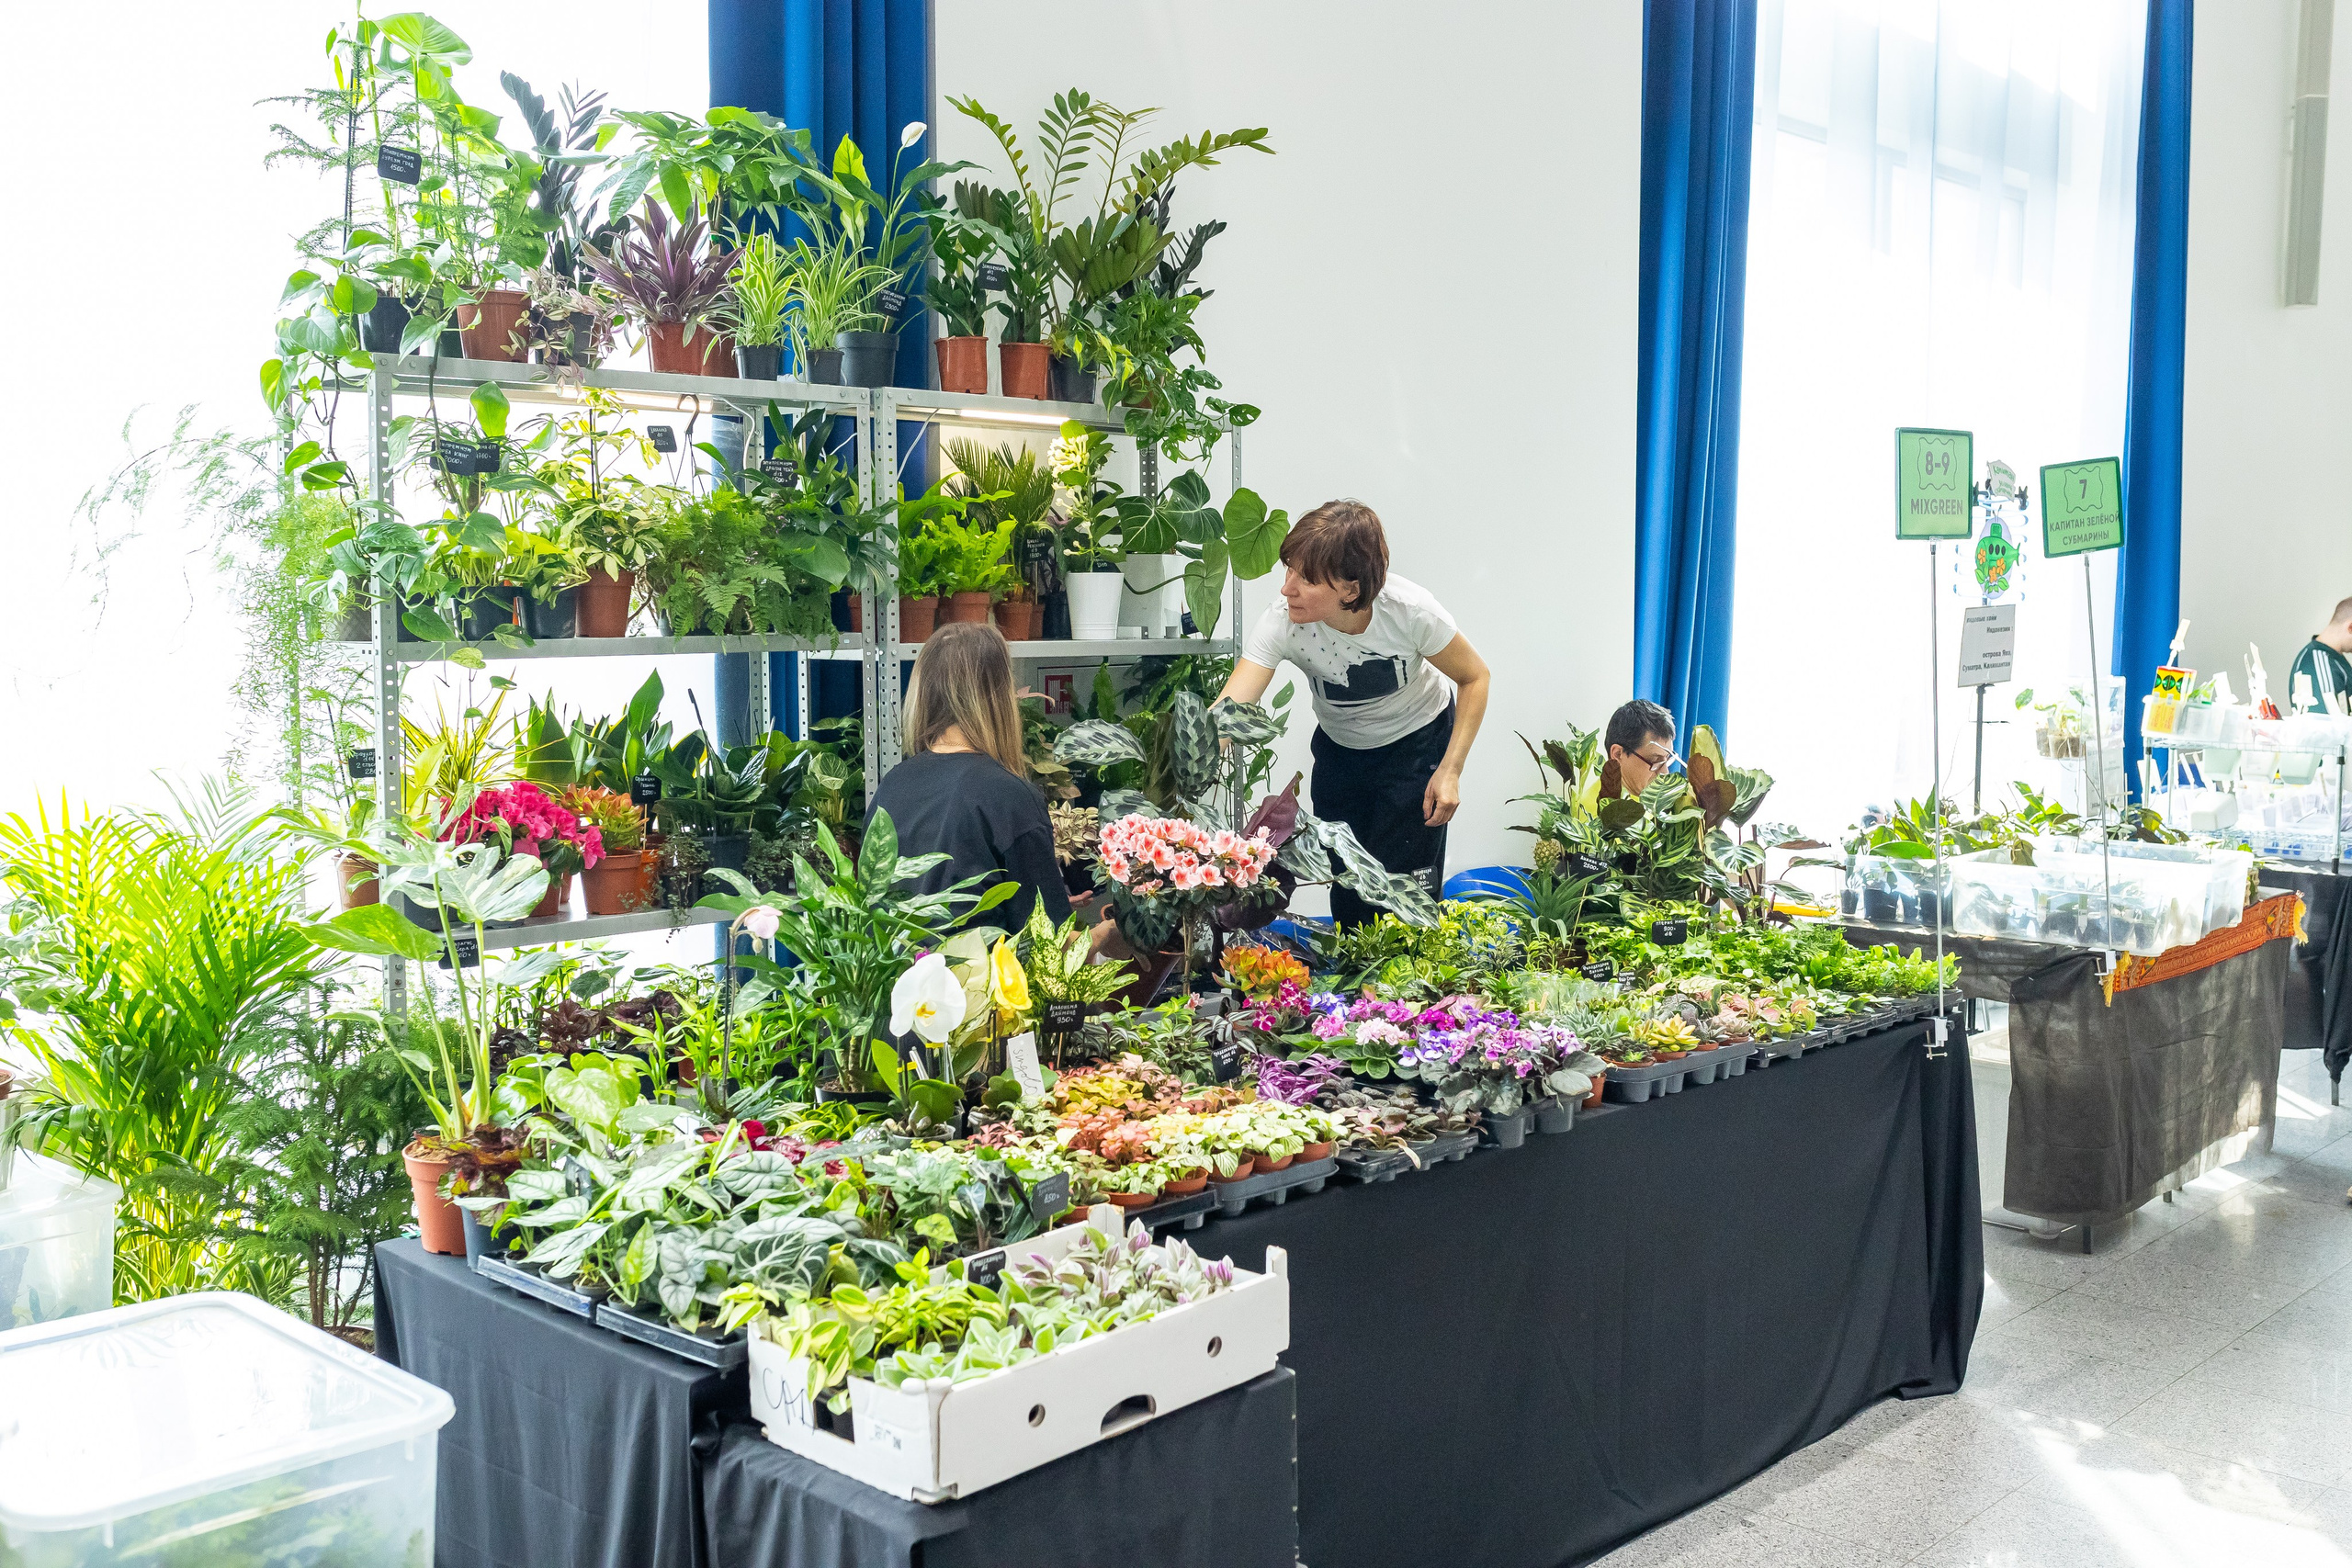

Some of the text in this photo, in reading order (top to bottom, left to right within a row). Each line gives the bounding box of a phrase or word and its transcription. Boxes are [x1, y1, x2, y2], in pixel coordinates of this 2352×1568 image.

[1925, 451, 1950, 476] 8-9
[2079, 479, 2087, 500] 7
[1911, 499, 1963, 515] MIXGREEN
[2049, 518, 2085, 533] КАПИТАН
[2063, 530, 2109, 546] СУБМАРИНЫ
